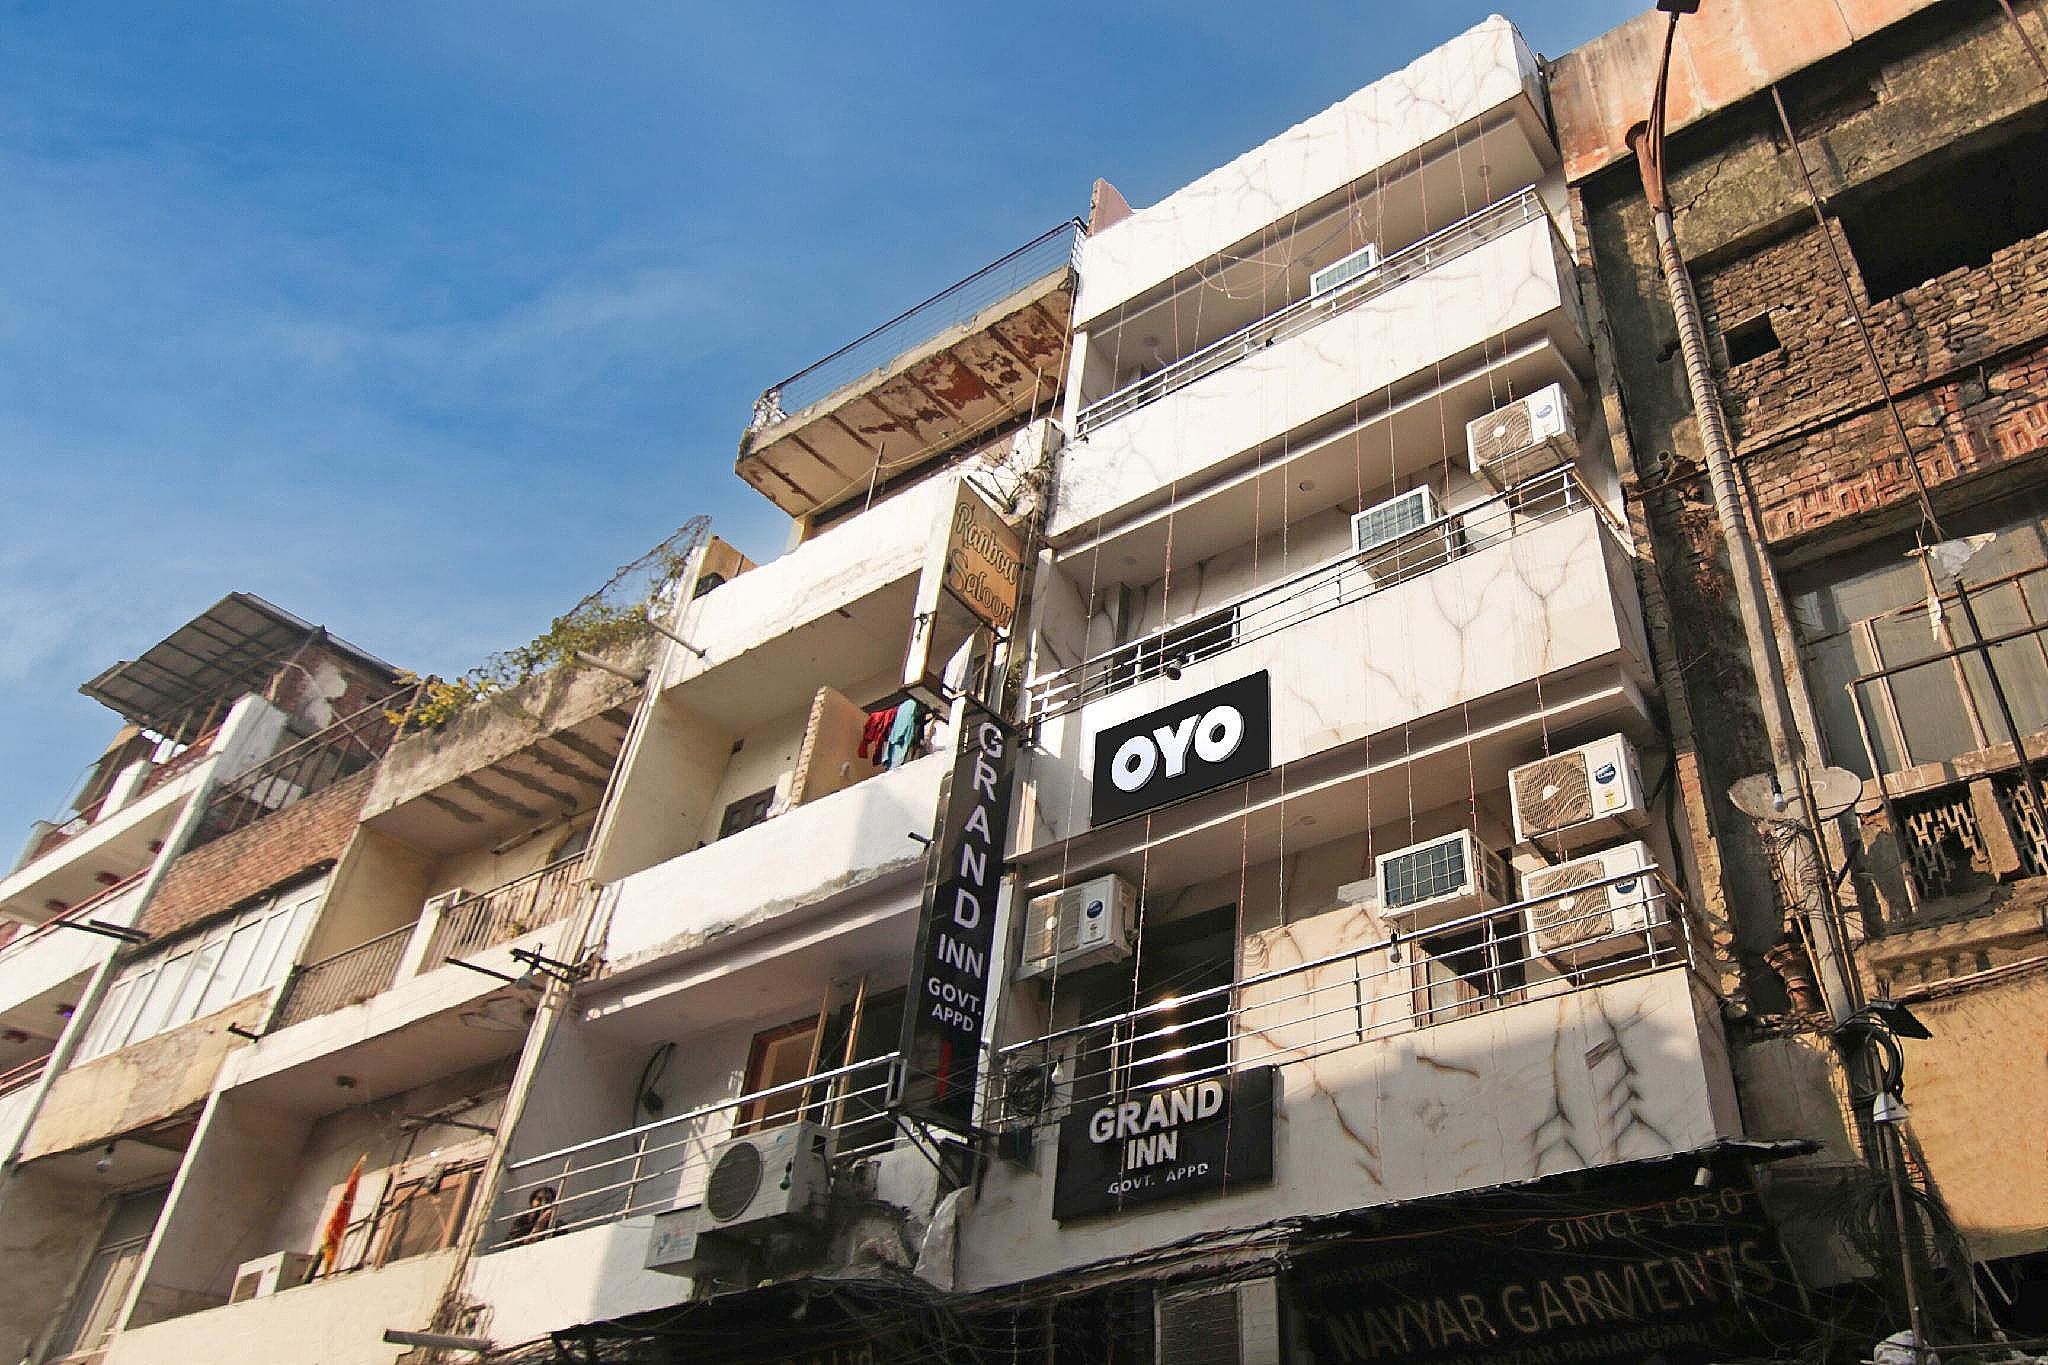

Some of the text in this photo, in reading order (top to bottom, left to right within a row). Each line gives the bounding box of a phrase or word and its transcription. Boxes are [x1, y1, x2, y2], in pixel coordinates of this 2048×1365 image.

[950, 549, 1013, 629] Saloon
[1111, 705, 1245, 793] OYO
[952, 721, 1002, 930] GRAND
[937, 933, 984, 979] INN
[928, 976, 982, 1016] GOVT.
[931, 1002, 975, 1033] APPD
[1088, 1079, 1224, 1144] GRAND
[1127, 1130, 1179, 1170] INN
[1546, 1186, 1744, 1251] SINCE 1950
[1326, 1294, 1499, 1363] NAYYAR
[1501, 1240, 1777, 1334] GARMENTS
